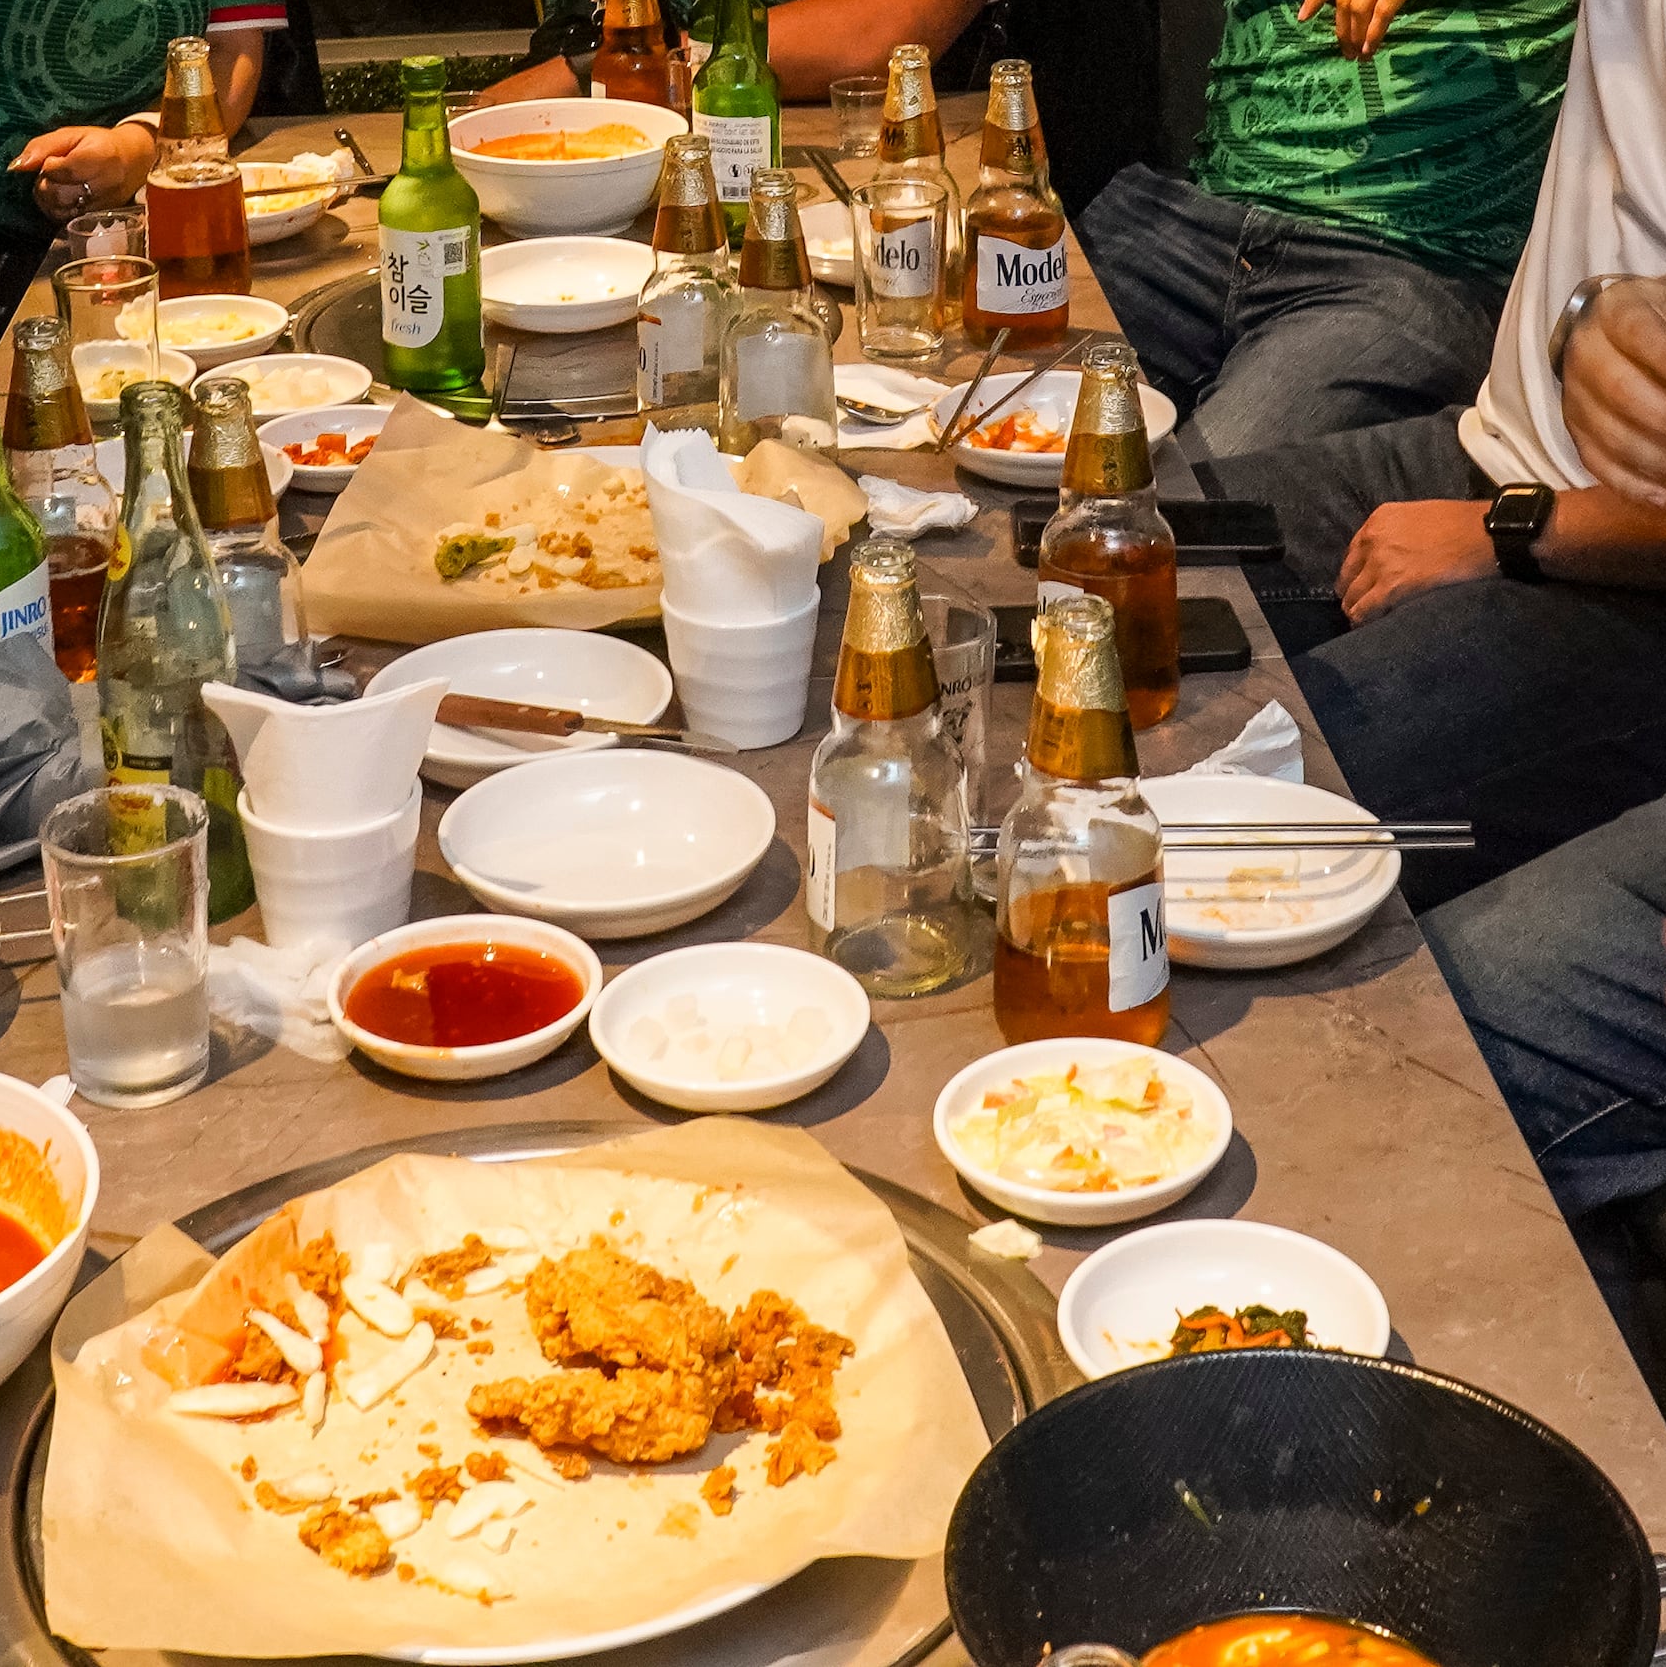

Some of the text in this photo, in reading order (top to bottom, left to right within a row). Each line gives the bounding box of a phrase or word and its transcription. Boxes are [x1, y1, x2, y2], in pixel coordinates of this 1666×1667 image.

[388, 251, 409, 284] 참
[389, 284, 433, 315] 이슬
[391, 317, 421, 335] fresh
[1, 595, 47, 639] JINRO
